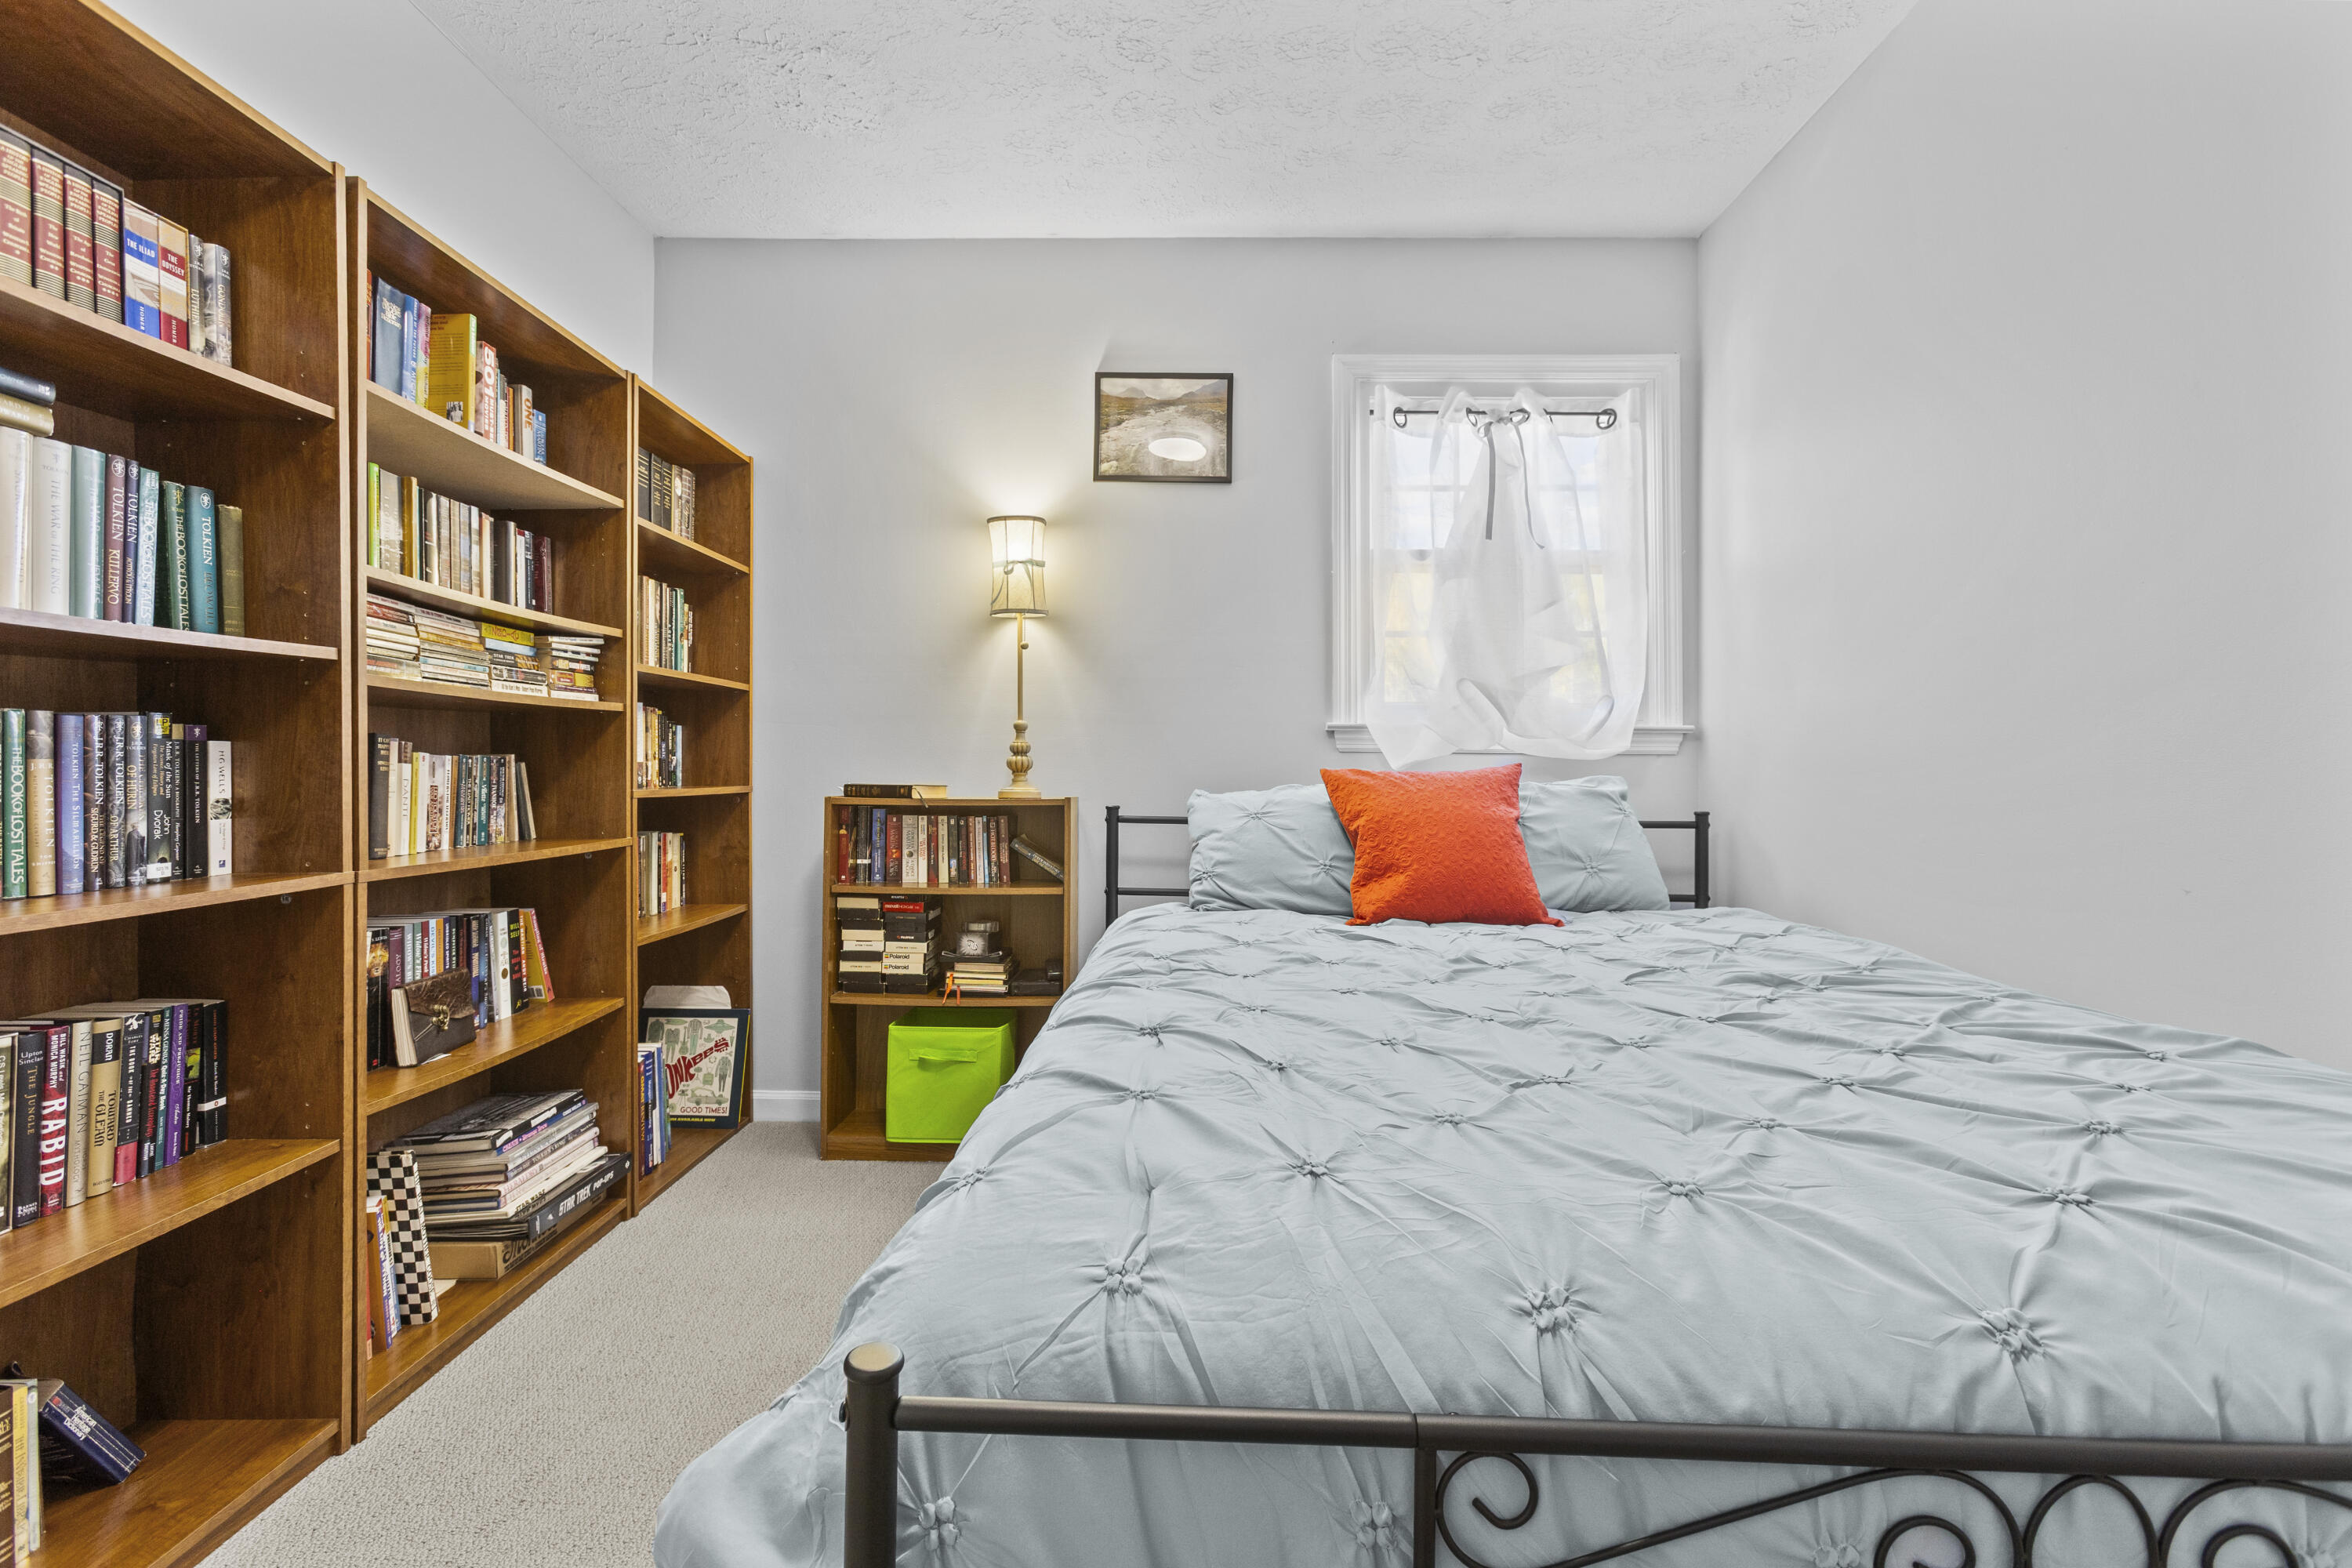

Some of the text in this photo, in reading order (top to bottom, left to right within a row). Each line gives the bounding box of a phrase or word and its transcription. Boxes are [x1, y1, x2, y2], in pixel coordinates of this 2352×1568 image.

[127, 238, 155, 258] THE ILIAD
[168, 253, 179, 264] THE
[162, 260, 185, 277] ODYSSEY
[218, 285, 227, 328] GONDOLIN
[484, 346, 495, 397] 501
[524, 398, 532, 432] ONE
[50, 504, 60, 529] WAR
[127, 492, 139, 543] TOLKIEN
[145, 502, 154, 517] THE
[176, 516, 185, 531] THE
[107, 486, 124, 604] TOLKIEN KULLERVO
[143, 516, 154, 548] BOOK
[176, 532, 186, 564] BOOK
[49, 568, 61, 594] RING
[142, 560, 152, 588] LOST
[201, 517, 214, 626] TOLKIEN BEOWULF
[141, 588, 151, 618] TALES
[178, 575, 188, 603] LOST
[180, 602, 190, 633] TALES
[95, 761, 104, 805] TOLKIEN
[116, 761, 125, 805] TOLKIEN
[126, 765, 136, 777] OF
[12, 746, 24, 884] THE BOOK OF LOST TALES
[154, 810, 162, 839] Dvorak
[110, 815, 118, 862] OF ARTHUR
[510, 922, 520, 931] WILL
[105, 1033, 114, 1062] DORAN
[148, 1033, 157, 1065] WARS
[77, 1032, 91, 1134] NEIL GAIMAN
[24, 1066, 38, 1135] THE JUNGLE
[107, 1090, 117, 1141] TOWARD
[40, 1097, 67, 1185] RABID
[94, 1104, 106, 1147] GLEAM
[515, 1189, 546, 1213] STAR WARS
[559, 1171, 614, 1217] STAR TREK POP-UPS
